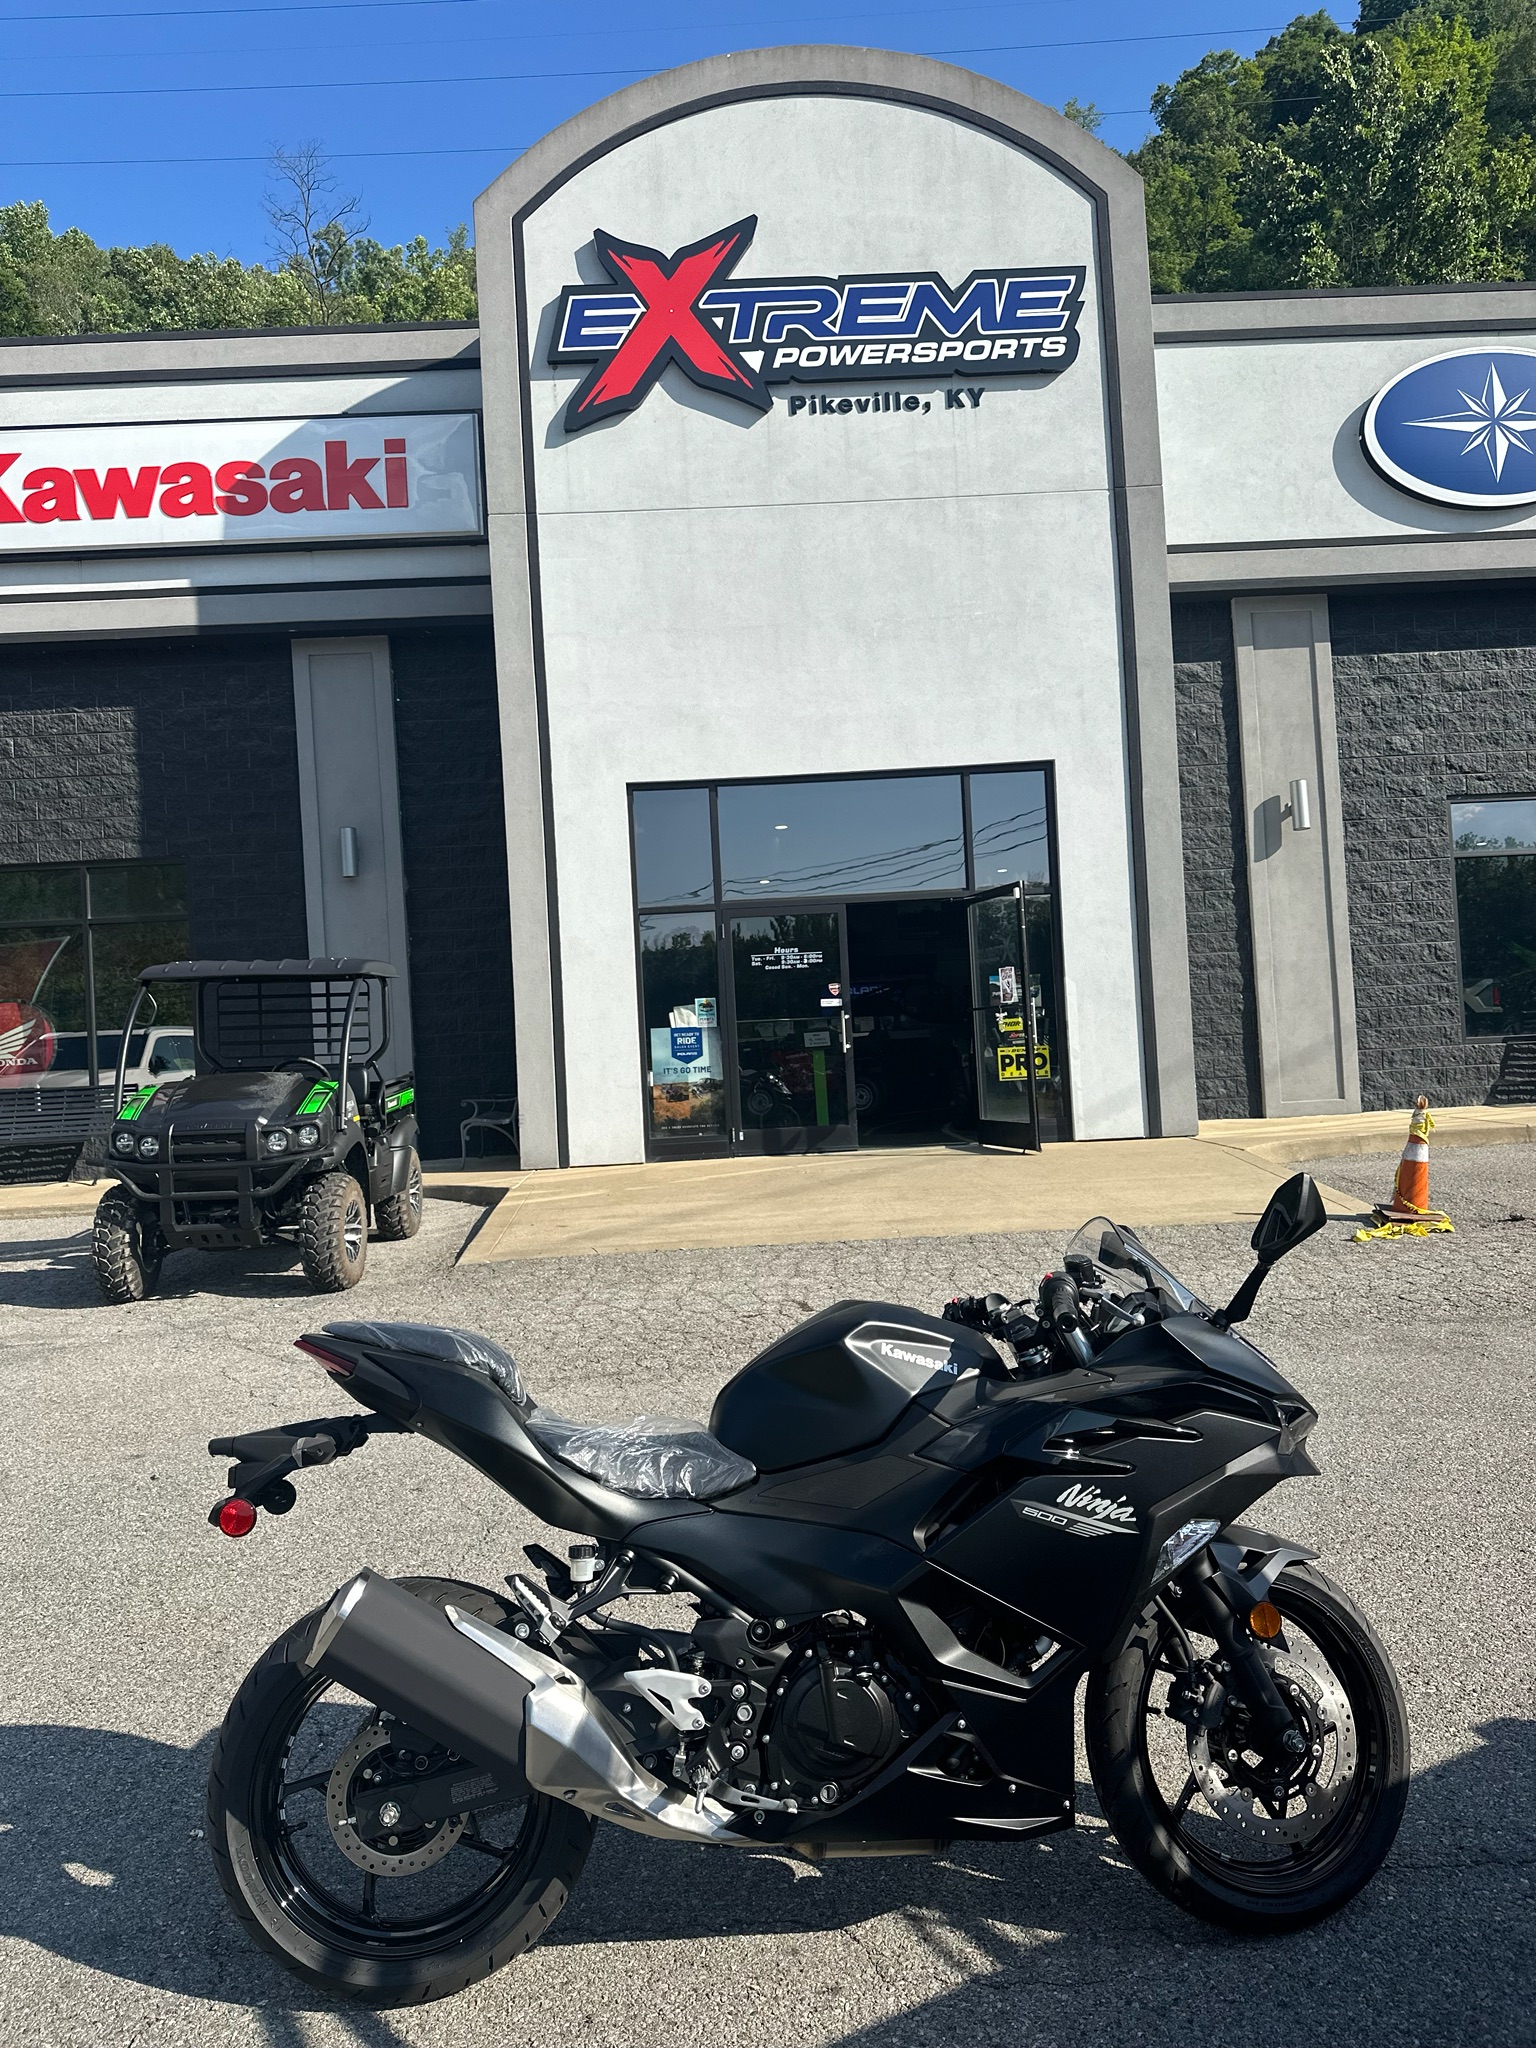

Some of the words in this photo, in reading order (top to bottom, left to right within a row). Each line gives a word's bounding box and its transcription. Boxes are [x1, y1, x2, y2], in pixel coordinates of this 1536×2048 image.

[558, 231, 1078, 413] EXTREME
[772, 334, 1067, 369] POWERSPORTS
[787, 390, 931, 417] Pikeville,
[944, 387, 986, 410] KY
[774, 946, 799, 954] Hours
[676, 1037, 697, 1045] RIDE
[663, 1067, 679, 1075] IT'S
[680, 1066, 691, 1074] GO
[693, 1065, 712, 1073] TIME
[1000, 1052, 1048, 1072] PRO
[880, 1342, 958, 1375] Kawasaki
[1056, 1483, 1137, 1522] Ninja
[1022, 1506, 1068, 1526] 500
